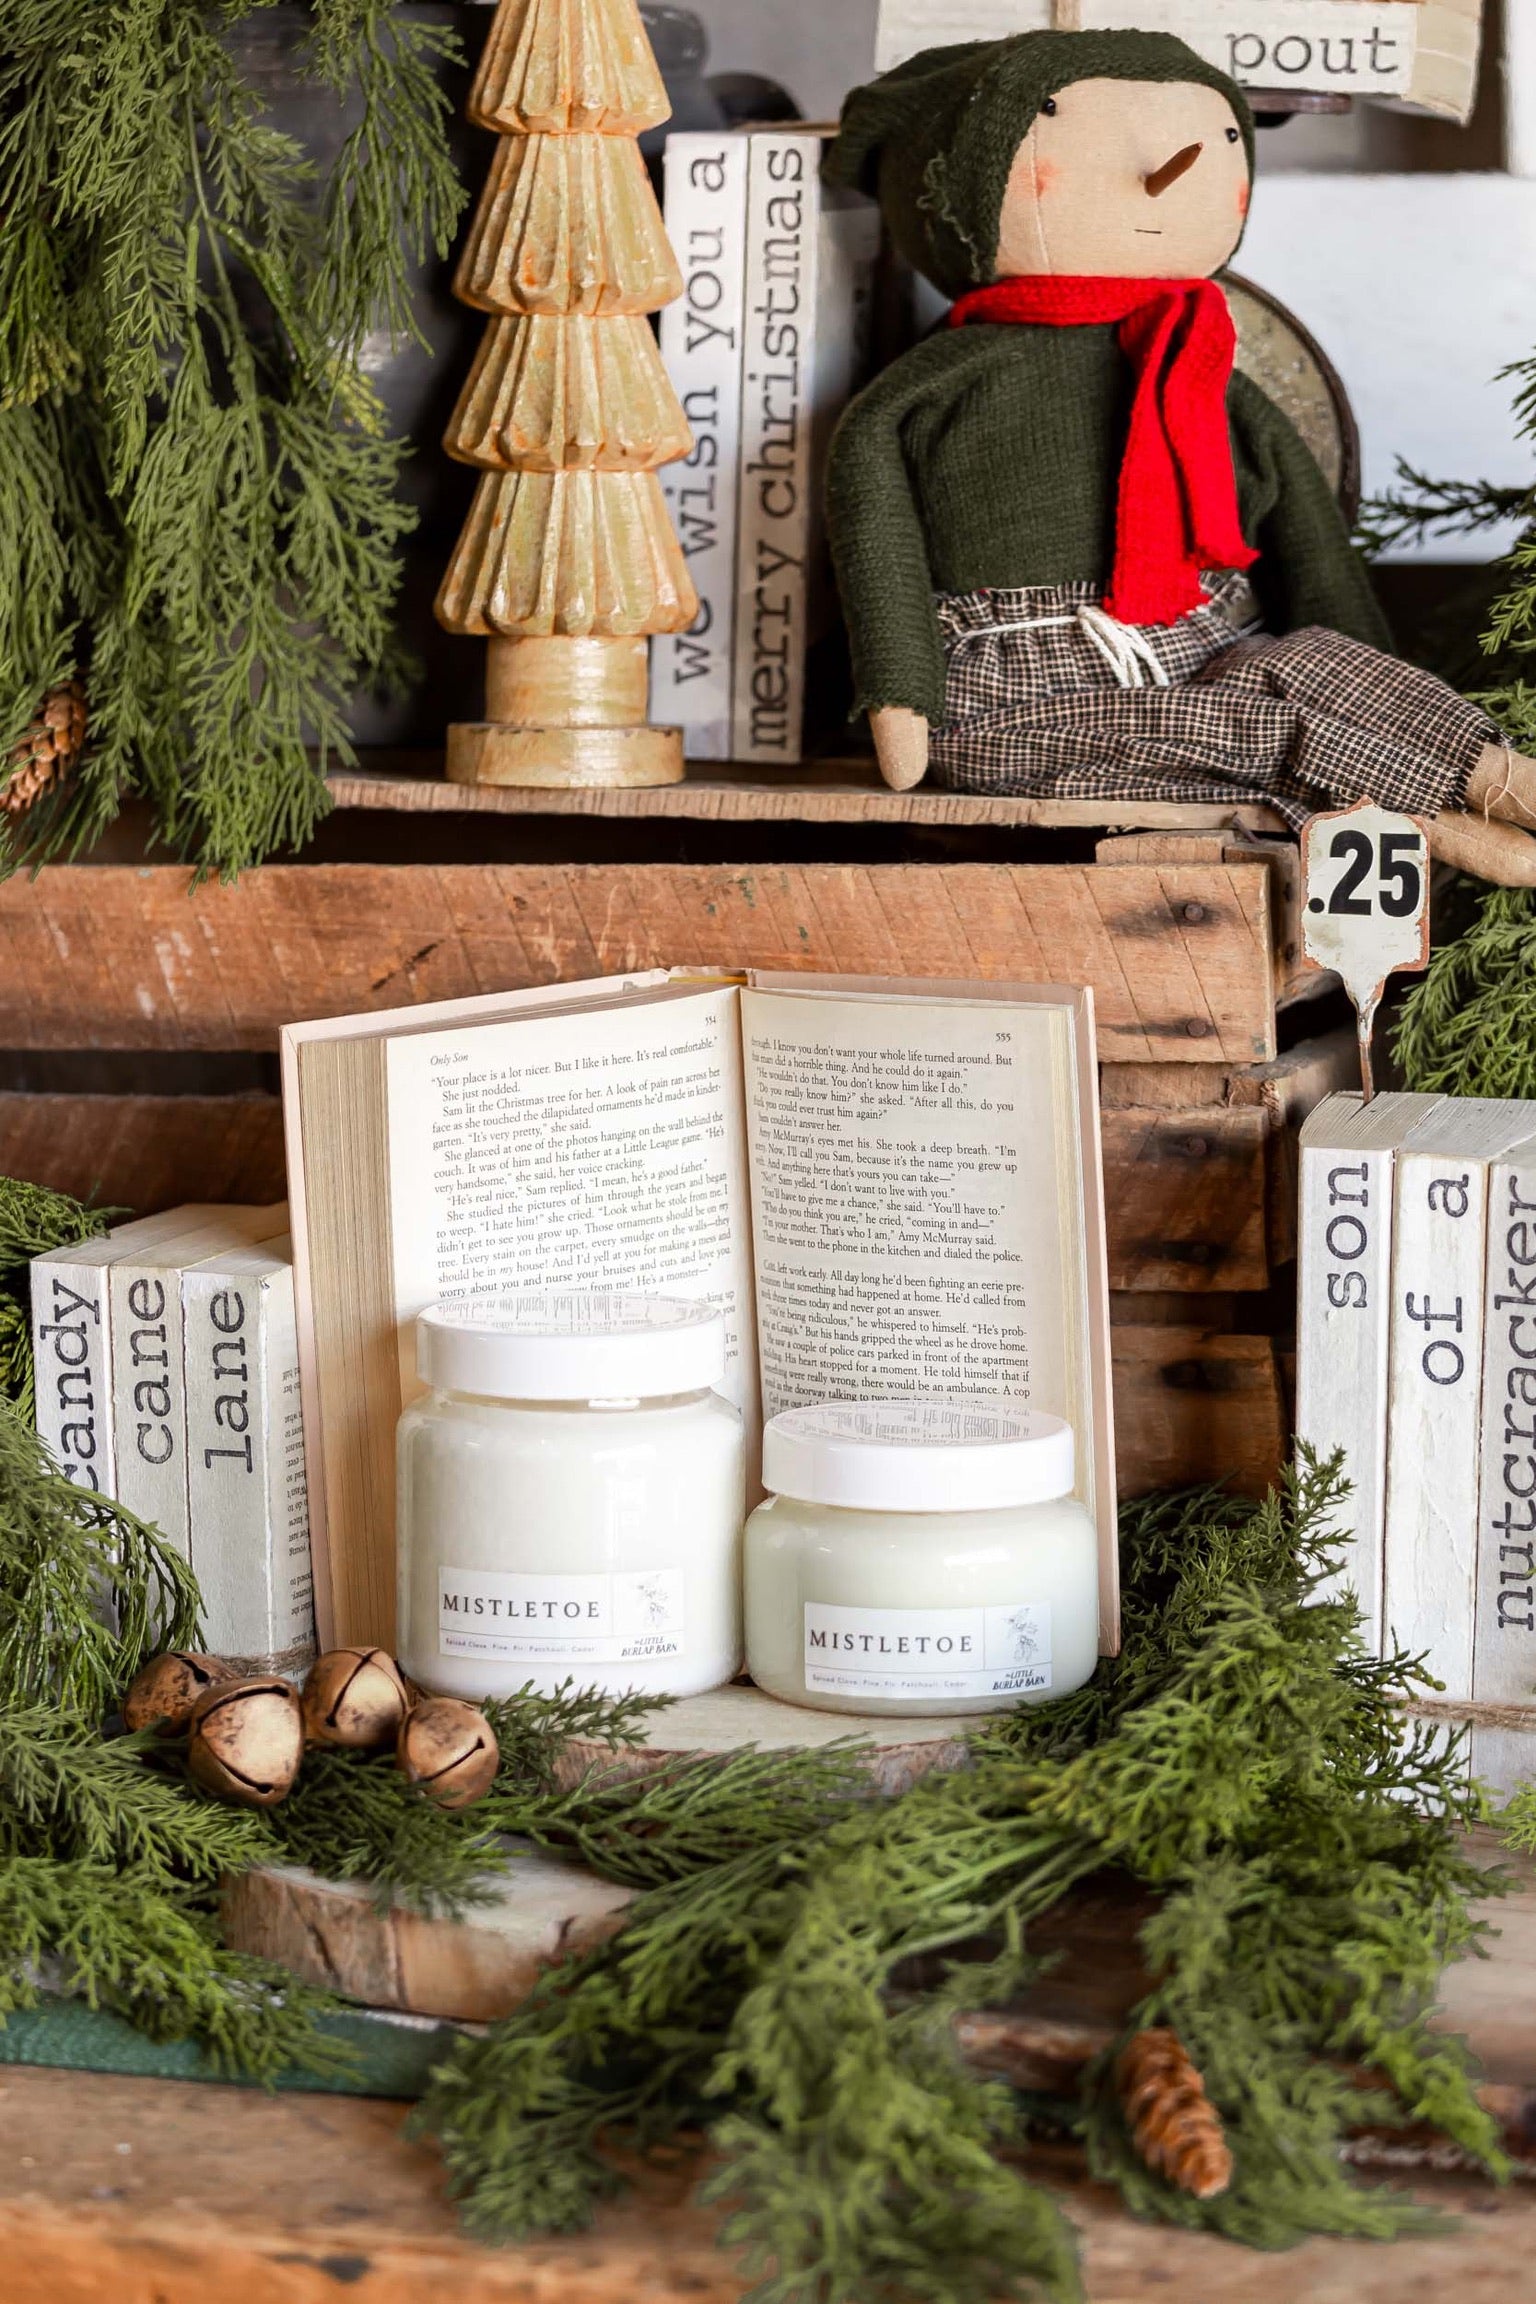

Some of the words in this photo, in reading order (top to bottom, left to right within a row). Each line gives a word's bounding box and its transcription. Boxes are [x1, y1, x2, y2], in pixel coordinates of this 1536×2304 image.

[1226, 27, 1400, 84] pout
[690, 152, 726, 192] a
[686, 227, 735, 352] you
[746, 148, 804, 519] christmas
[751, 540, 803, 750] merry
[1308, 829, 1421, 918] .25
[430, 1056, 450, 1066] Only
[453, 1052, 468, 1062] Son
[814, 1044, 833, 1055] don't
[836, 1048, 855, 1058] want
[858, 1050, 877, 1060] your
[880, 1048, 905, 1060] whole
[908, 1050, 922, 1061] life
[925, 1052, 954, 1063] turned
[957, 1054, 993, 1065] around.
[996, 1054, 1012, 1065] But
[996, 1033, 1011, 1042] 555
[463, 1072, 486, 1086] place
[491, 1070, 497, 1080] is
[510, 1067, 522, 1078] lot
[525, 1066, 550, 1076] nicer.
[555, 1062, 571, 1072] But
[575, 1059, 579, 1070] I
[583, 1058, 599, 1069] like
[602, 1057, 610, 1066] it
[612, 1055, 633, 1065] here.
[653, 1046, 667, 1059] real
[432, 1122, 450, 1133] face
[454, 1122, 462, 1130] as
[465, 1118, 480, 1129] she
[483, 1112, 521, 1126] touched
[524, 1111, 538, 1121] the
[541, 1102, 594, 1120] dilapidated
[597, 1098, 642, 1112] ornaments
[665, 1089, 686, 1102] made
[688, 1088, 694, 1098] in
[442, 1091, 459, 1102] She
[462, 1089, 478, 1101] just
[482, 1082, 520, 1096] nodded.
[443, 1106, 462, 1116] Sam
[466, 1103, 475, 1113] lit
[479, 1101, 493, 1112] the
[497, 1096, 544, 1110] Christmas
[548, 1094, 565, 1103] tree
[569, 1090, 582, 1100] for
[586, 1087, 602, 1098] her.
[606, 1086, 613, 1096] A
[616, 1081, 636, 1094] look
[639, 1080, 648, 1090] of
[651, 1077, 668, 1092] pain
[671, 1077, 683, 1086] ran
[432, 1137, 464, 1150] garten.
[490, 1132, 509, 1142] very
[551, 1122, 566, 1133] she
[569, 1119, 591, 1130] said.
[434, 1165, 464, 1178] couch.
[468, 1163, 476, 1173] It
[479, 1164, 496, 1172] was
[500, 1160, 509, 1169] of
[513, 1157, 530, 1168] him
[535, 1153, 552, 1165] and
[556, 1151, 569, 1162] his
[572, 1147, 600, 1160] father
[604, 1146, 612, 1156] at
[624, 1141, 647, 1154] Little
[650, 1137, 679, 1149] League
[682, 1134, 703, 1146] game.
[445, 1151, 461, 1162] She
[464, 1145, 500, 1161] glanced
[503, 1146, 511, 1154] at
[515, 1143, 532, 1152] one
[535, 1140, 544, 1150] of
[548, 1137, 563, 1148] the
[566, 1134, 598, 1148] photos
[601, 1129, 636, 1142] hanging
[639, 1127, 650, 1135] on
[653, 1123, 665, 1133] the
[668, 1119, 684, 1130] wall
[686, 1114, 710, 1127] behind
[800, 1148, 812, 1158] call
[815, 1152, 829, 1161] you
[833, 1153, 853, 1163] Sam,
[857, 1152, 890, 1165] because
[910, 1157, 924, 1167] the
[928, 1160, 953, 1168] name
[957, 1162, 974, 1171] you
[978, 1163, 1001, 1172] grew
[1005, 1164, 1017, 1174] up
[1428, 1173, 1469, 1218] a
[777, 1234, 787, 1244] she
[789, 1238, 805, 1247] went
[808, 1240, 815, 1248] to
[818, 1239, 830, 1250] the
[832, 1241, 858, 1253] phone
[861, 1243, 868, 1253] in
[871, 1244, 885, 1254] the
[888, 1245, 920, 1257] kitchen
[924, 1247, 940, 1258] and
[944, 1248, 972, 1259] dialed
[975, 1250, 990, 1260] the
[993, 1250, 1023, 1263] police.
[1326, 1161, 1370, 1309] son
[793, 1342, 816, 1354] couple
[819, 1344, 826, 1353] of
[830, 1345, 854, 1356] police
[858, 1349, 874, 1358] cars
[878, 1350, 909, 1360] parked
[913, 1351, 921, 1360] in
[925, 1352, 947, 1362] front
[951, 1352, 960, 1363] of
[964, 1354, 979, 1364] the
[982, 1356, 1028, 1367] apartment
[1405, 1290, 1465, 1386] of
[129, 1278, 173, 1464] cane
[205, 1290, 253, 1473] lane
[1492, 1174, 1536, 1632] nutcracker
[443, 1593, 599, 1618] MISTLETOE
[810, 1629, 972, 1653] MISTLETOE
